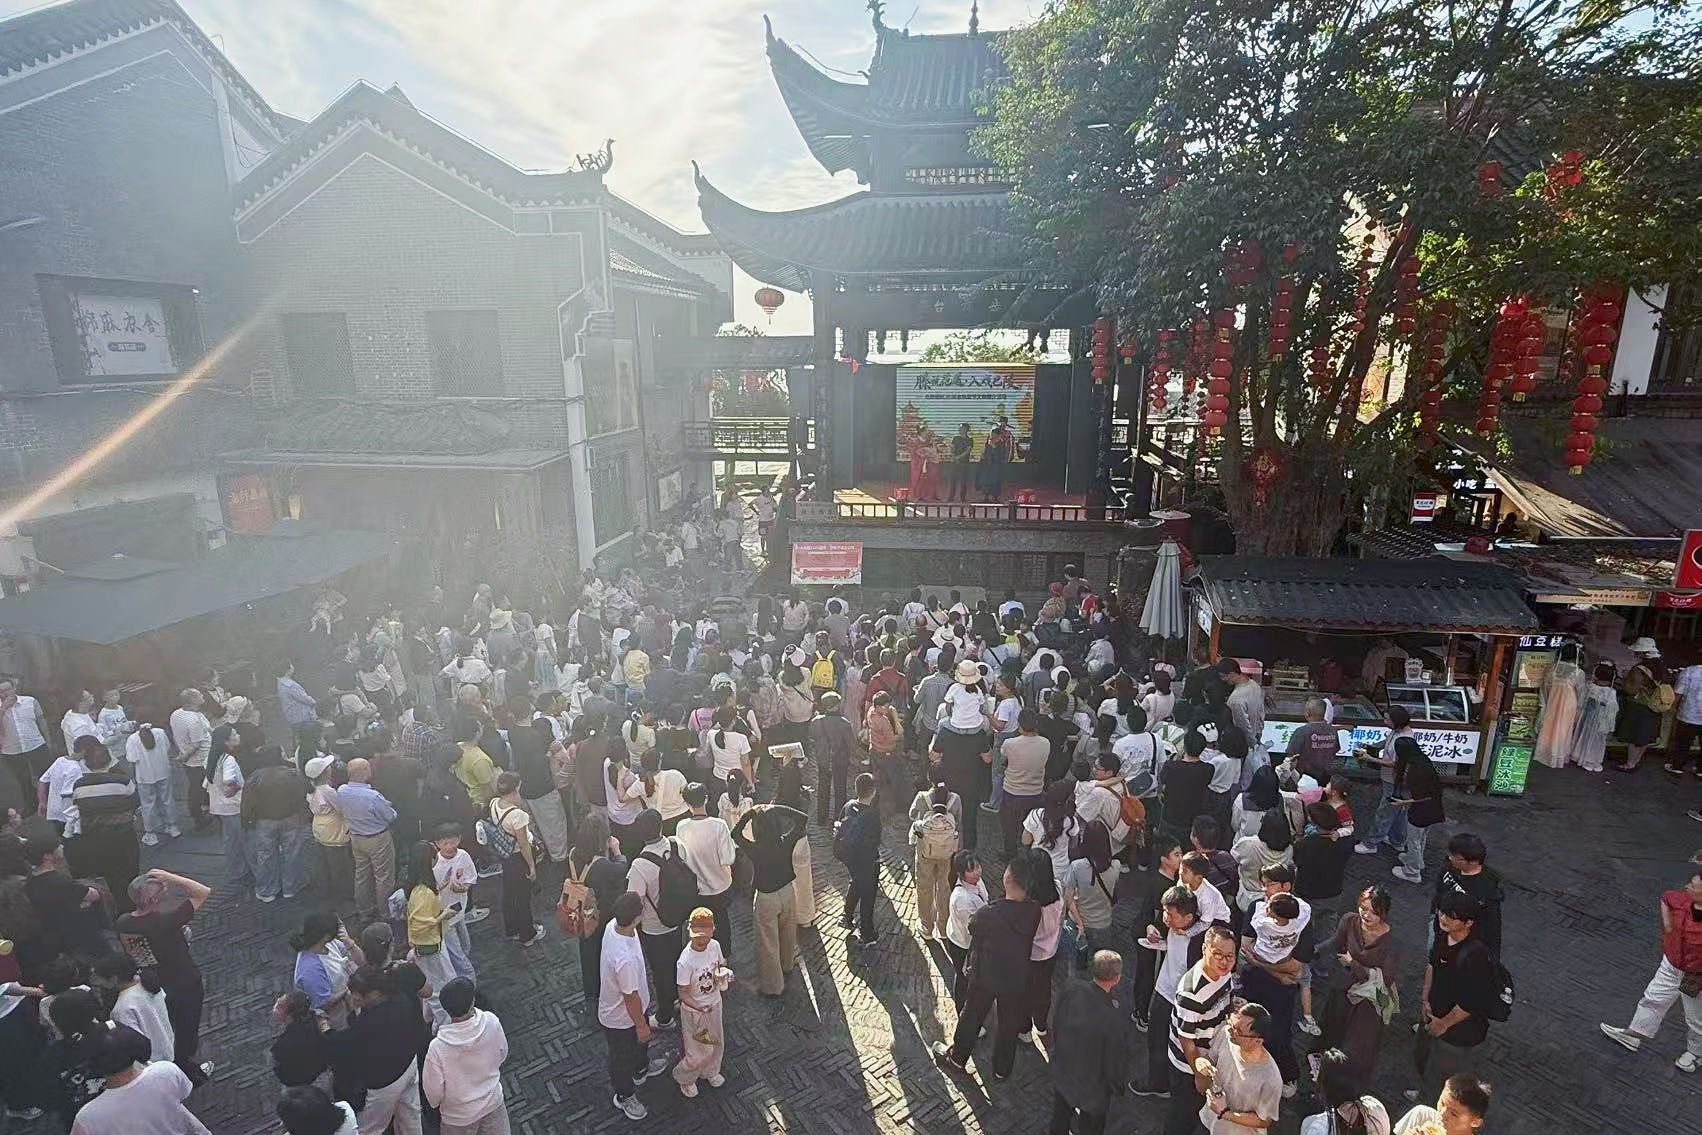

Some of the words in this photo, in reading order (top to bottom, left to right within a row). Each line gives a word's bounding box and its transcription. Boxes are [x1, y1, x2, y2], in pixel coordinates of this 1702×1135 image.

[1453, 478, 1477, 489] 小吃
[1519, 635, 1562, 647] 仙豆糕
